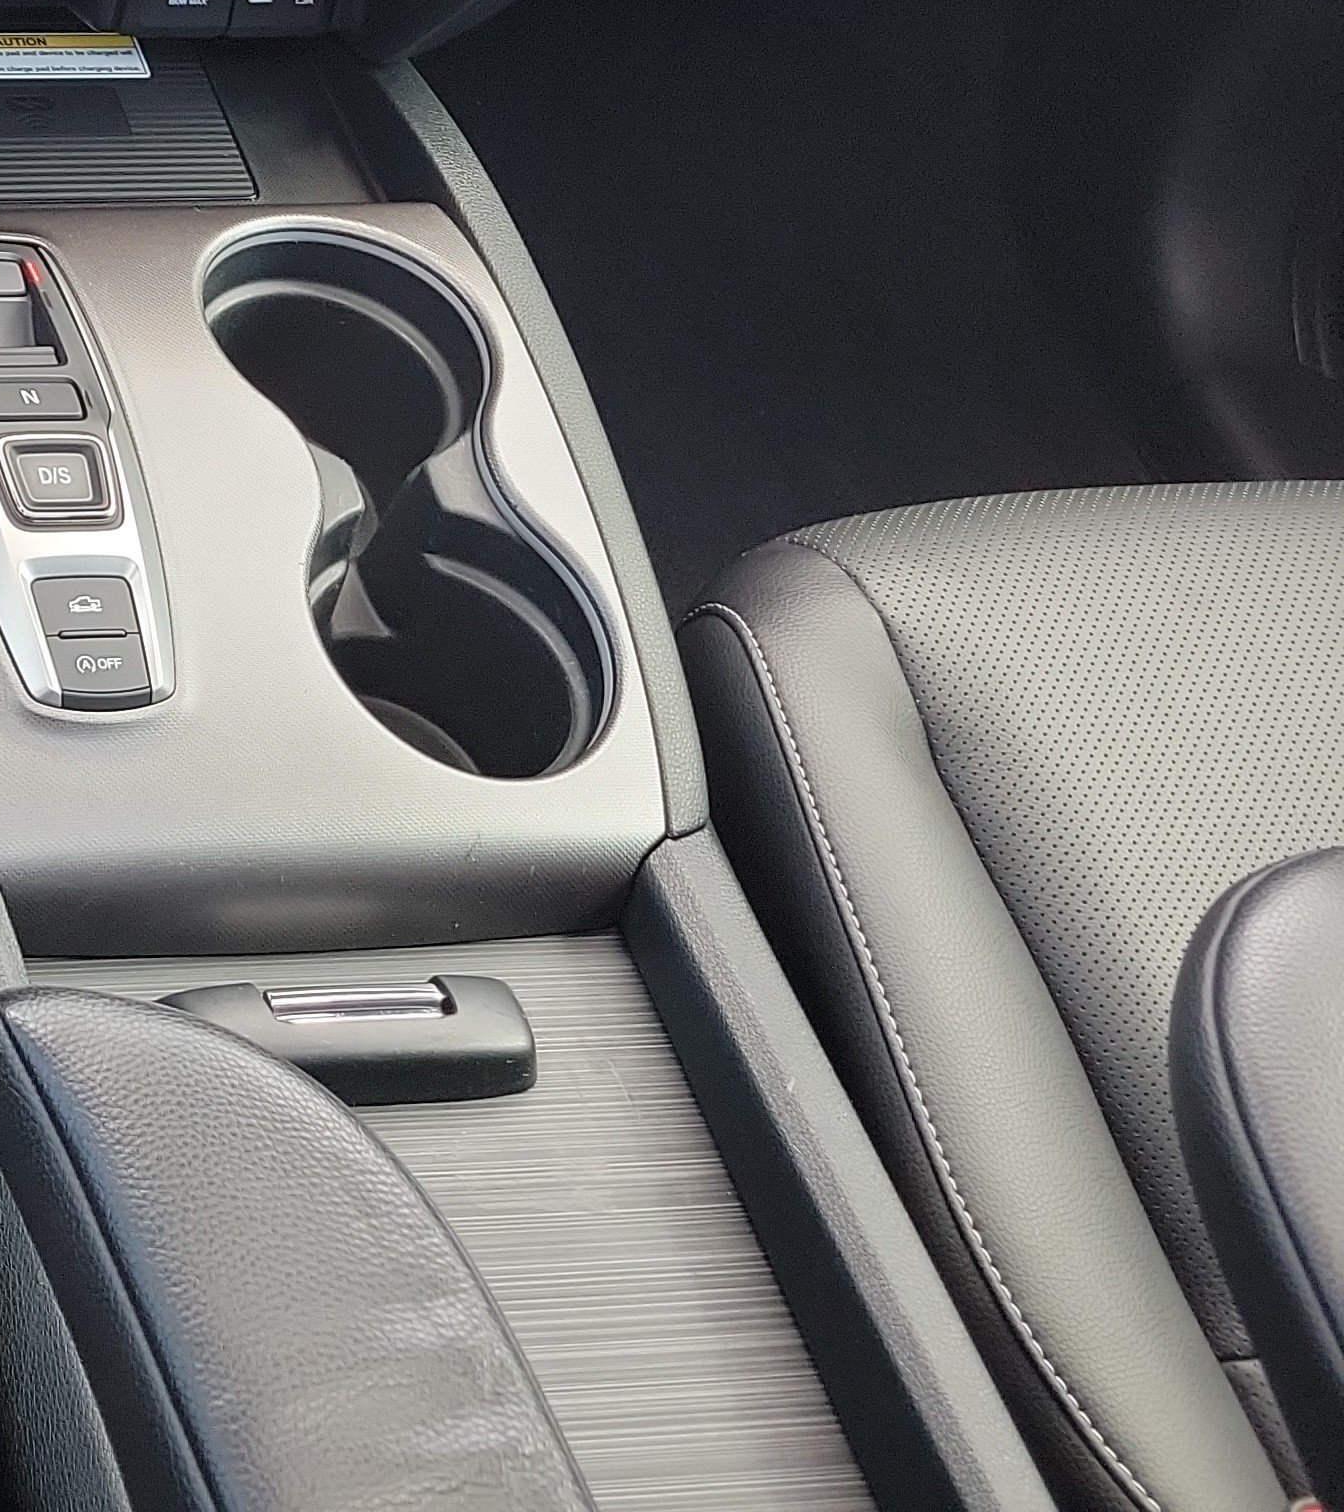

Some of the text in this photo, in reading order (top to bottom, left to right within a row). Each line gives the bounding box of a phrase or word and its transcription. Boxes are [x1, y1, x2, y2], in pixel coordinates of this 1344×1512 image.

[20, 389, 40, 406] N
[37, 466, 72, 485] D/S
[97, 656, 123, 671] OFF
